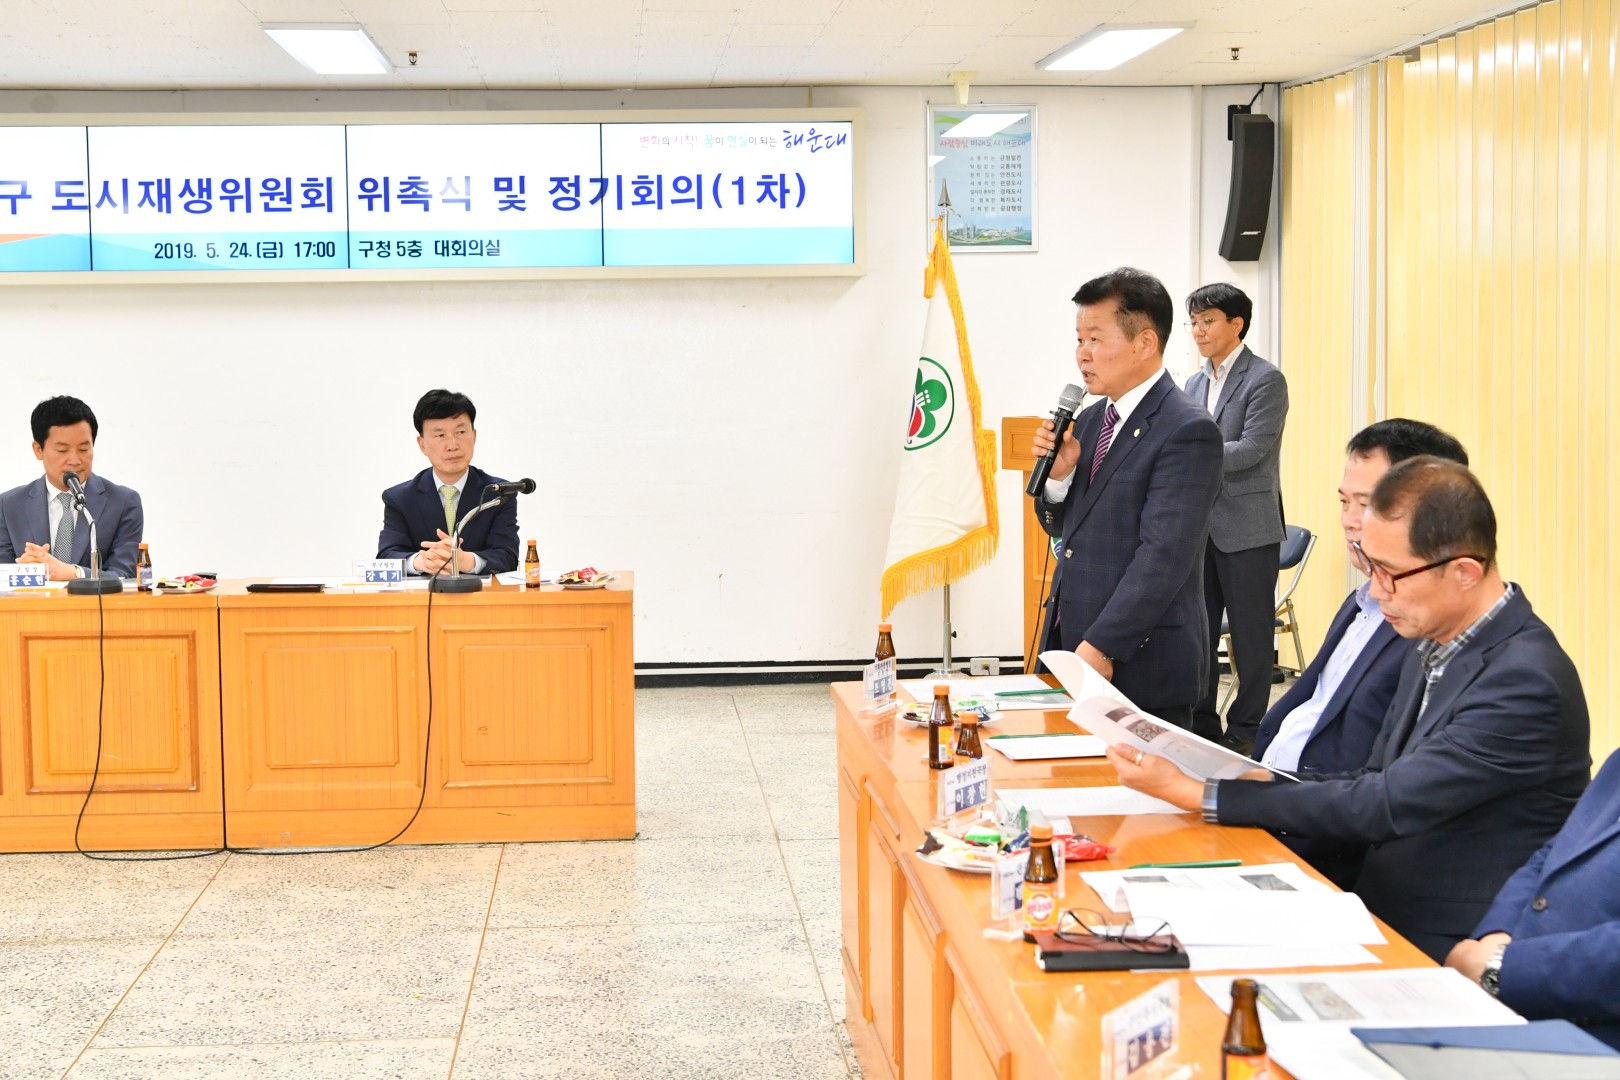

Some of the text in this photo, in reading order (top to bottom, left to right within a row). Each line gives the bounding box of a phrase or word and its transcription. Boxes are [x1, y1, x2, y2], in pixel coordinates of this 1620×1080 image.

[640, 127, 847, 153] 변화의 시작! 꿈이 현실이 되는 해운대
[970, 139, 1000, 147] 미래도시
[1002, 139, 1026, 147] 해운대
[0, 172, 807, 215] 구 도시재생위원회 위촉식 및 정기회의(1차)
[154, 243, 197, 259] 2019.
[206, 243, 220, 259] 5.
[294, 241, 336, 258] 17:00
[434, 239, 500, 257] 대회의실
